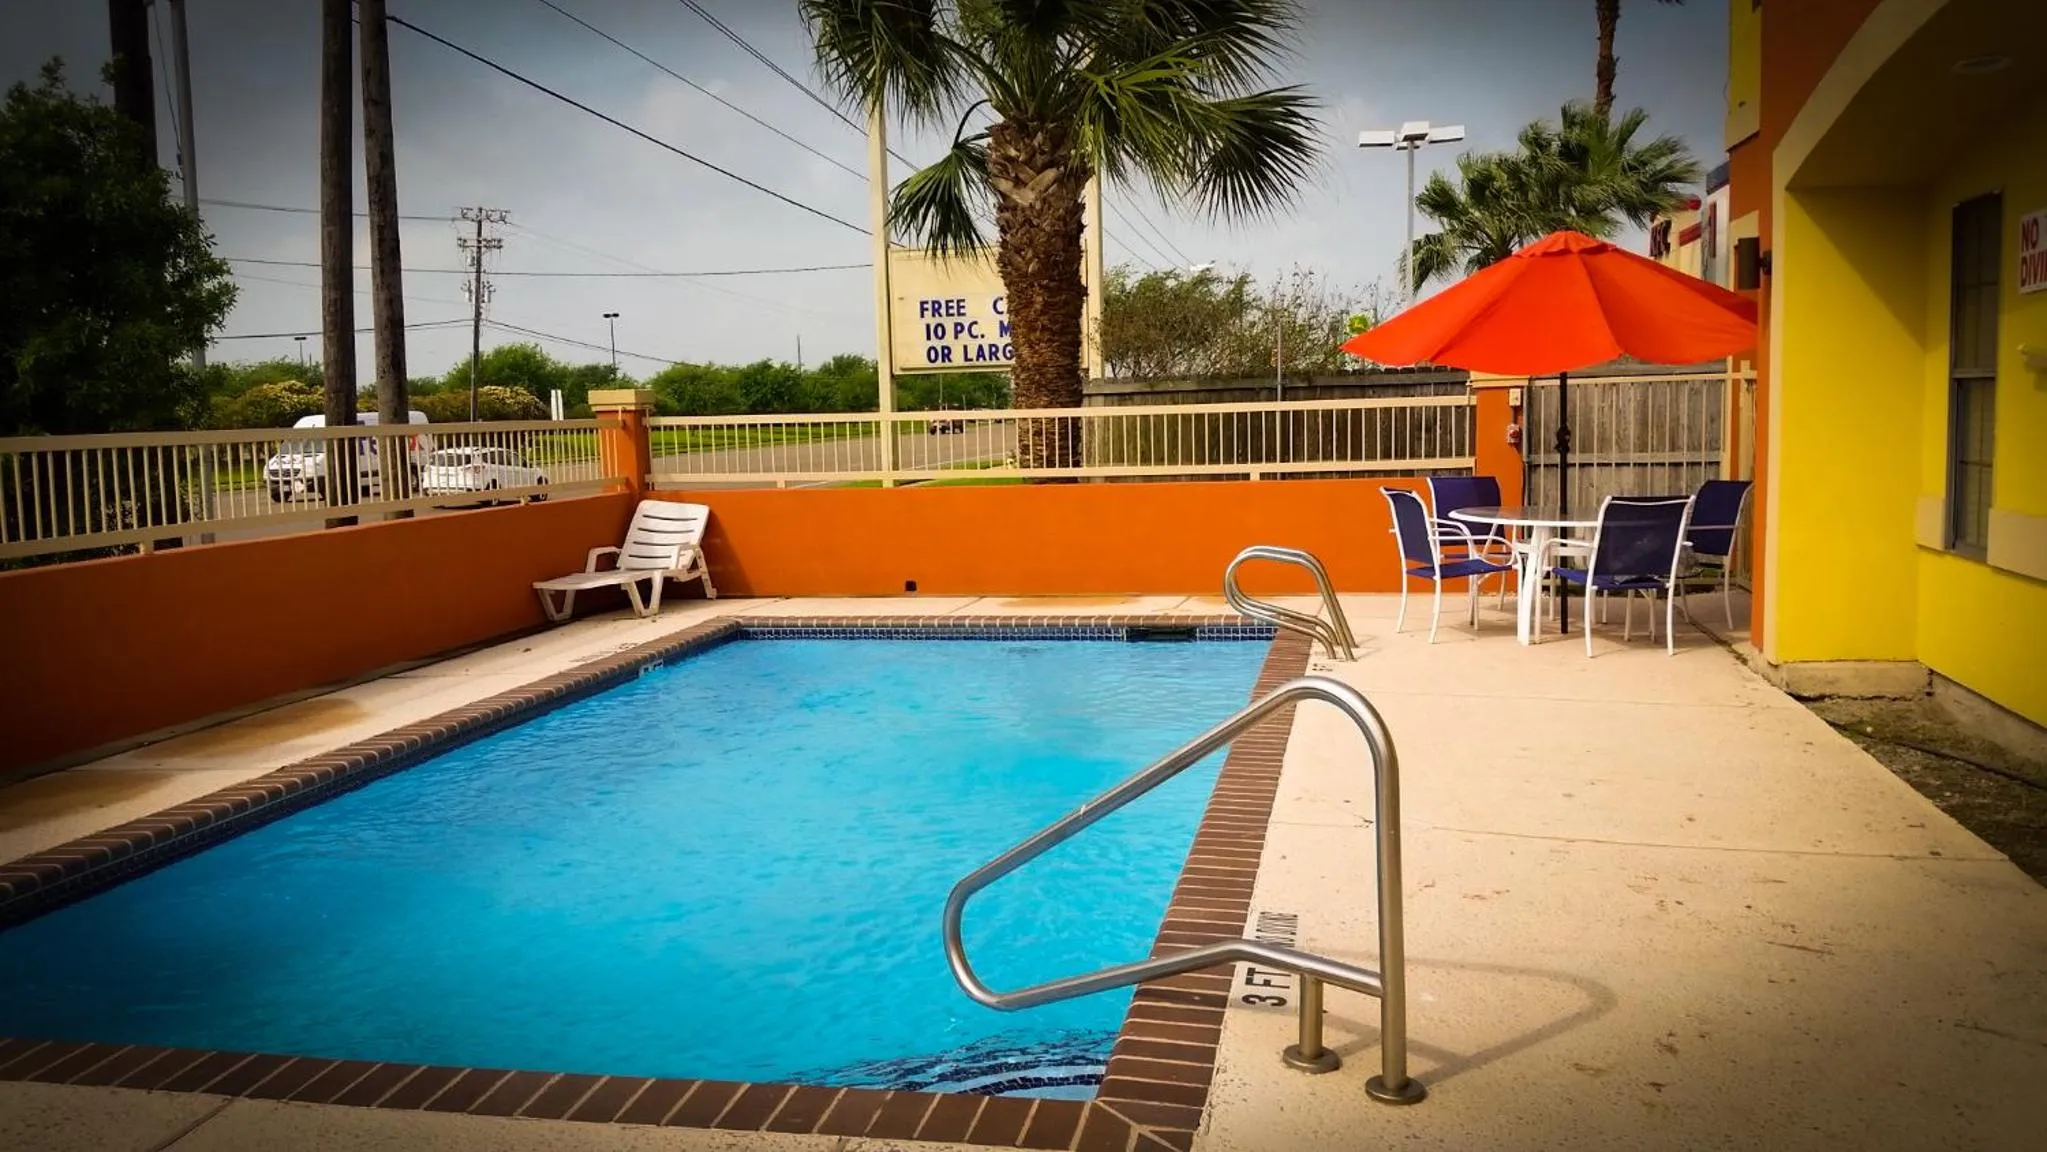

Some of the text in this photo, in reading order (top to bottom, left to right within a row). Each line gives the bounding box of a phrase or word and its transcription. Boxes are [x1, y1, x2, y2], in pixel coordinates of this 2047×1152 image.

[2021, 217, 2038, 252] NO
[920, 298, 966, 318] FREE
[925, 323, 946, 341] 10
[953, 320, 985, 340] PC.
[926, 343, 1015, 363] OR LARG
[1245, 967, 1292, 989] FT
[1241, 994, 1287, 1007] 3
